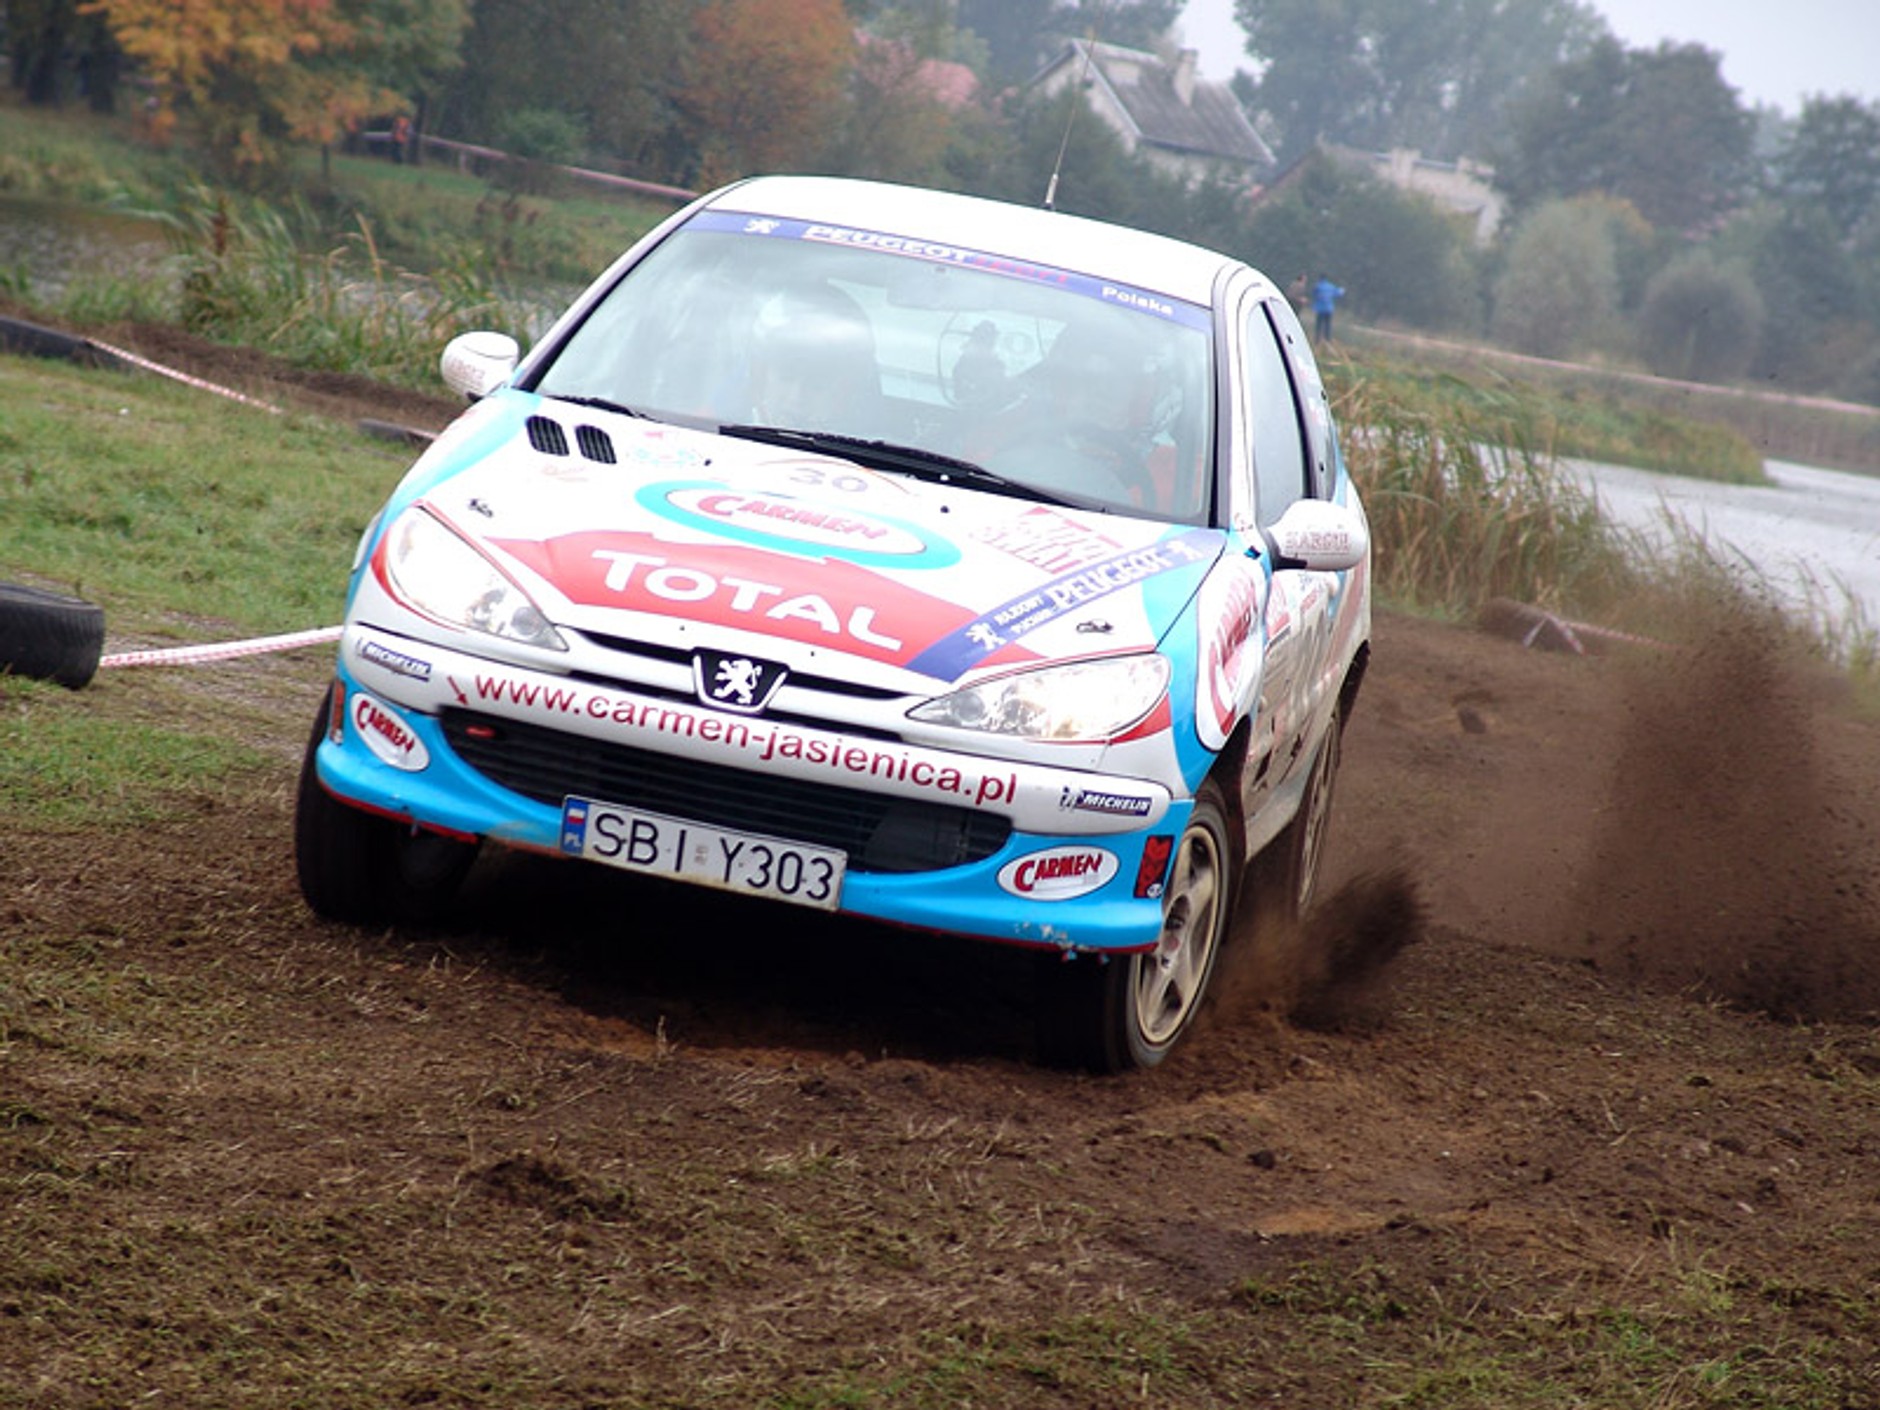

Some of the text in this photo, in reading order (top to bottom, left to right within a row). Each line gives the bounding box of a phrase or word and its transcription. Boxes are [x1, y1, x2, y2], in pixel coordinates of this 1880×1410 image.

[801, 224, 974, 263] PEUGEOT
[1102, 286, 1173, 316] Polska
[789, 467, 869, 494] 30
[697, 493, 889, 541] CARMEN
[591, 549, 903, 651] TOTAL
[1045, 552, 1173, 610] PEUGEOT
[364, 641, 431, 676] MICHELIN
[356, 699, 416, 754] CARMEN
[475, 674, 1017, 806] www.carmen-jasienica.pl
[1082, 793, 1150, 812] MICHELIN
[718, 836, 835, 901] Y303
[1013, 852, 1104, 892] CARMEN
